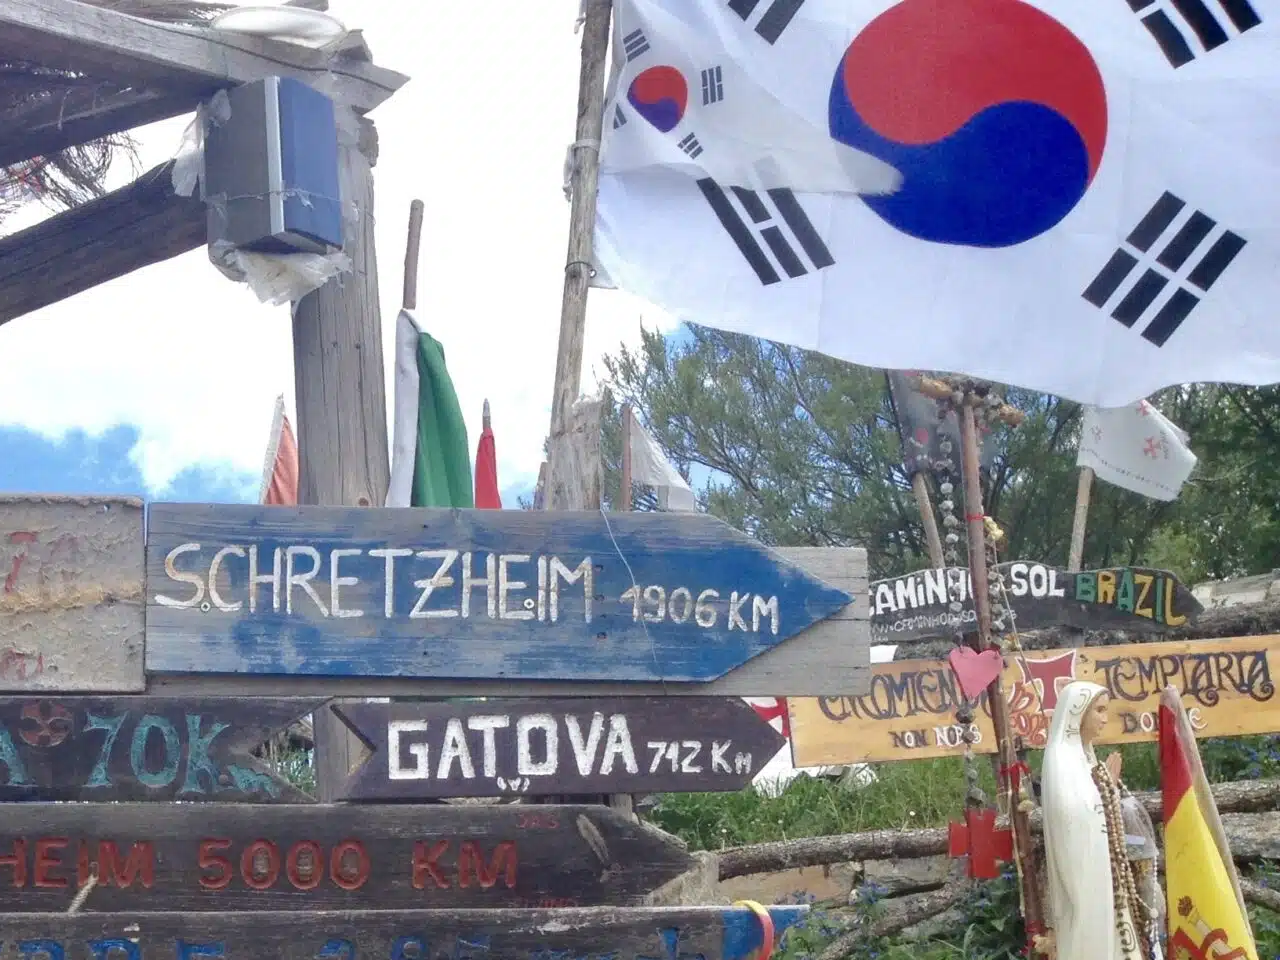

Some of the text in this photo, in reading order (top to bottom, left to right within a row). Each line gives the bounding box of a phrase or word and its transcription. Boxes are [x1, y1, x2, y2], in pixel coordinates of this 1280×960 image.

[154, 542, 779, 635] SCHRETZHEIM 1906 KM
[1011, 564, 1065, 598] SOL
[1076, 566, 1187, 626] BRAZIL
[387, 711, 640, 780] GATOVA
[888, 728, 930, 748] NON
[933, 723, 982, 747] NOBS
[198, 837, 370, 891] 5000
[412, 837, 517, 889] KM
